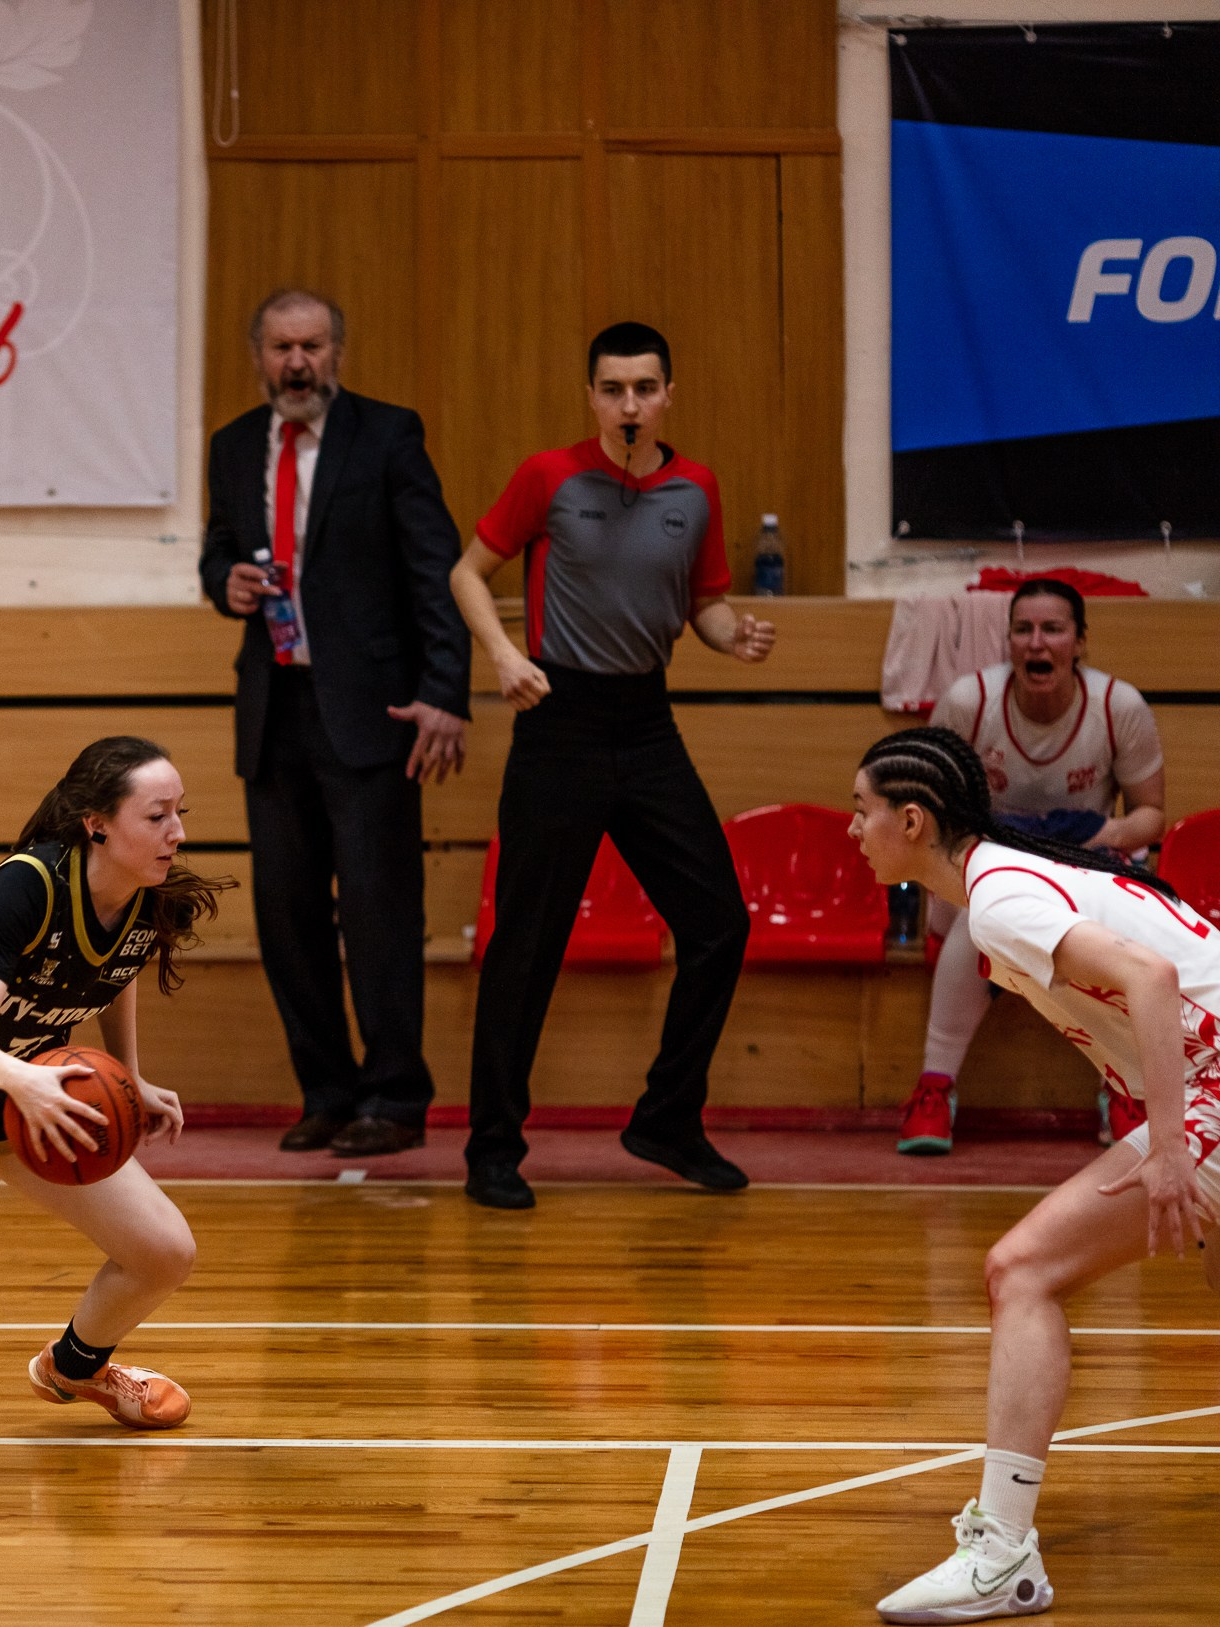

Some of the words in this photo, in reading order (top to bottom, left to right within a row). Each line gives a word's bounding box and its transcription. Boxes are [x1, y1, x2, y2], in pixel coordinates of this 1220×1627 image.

[1067, 235, 1220, 324] FO
[126, 928, 158, 944] FON
[119, 942, 152, 957] BET
